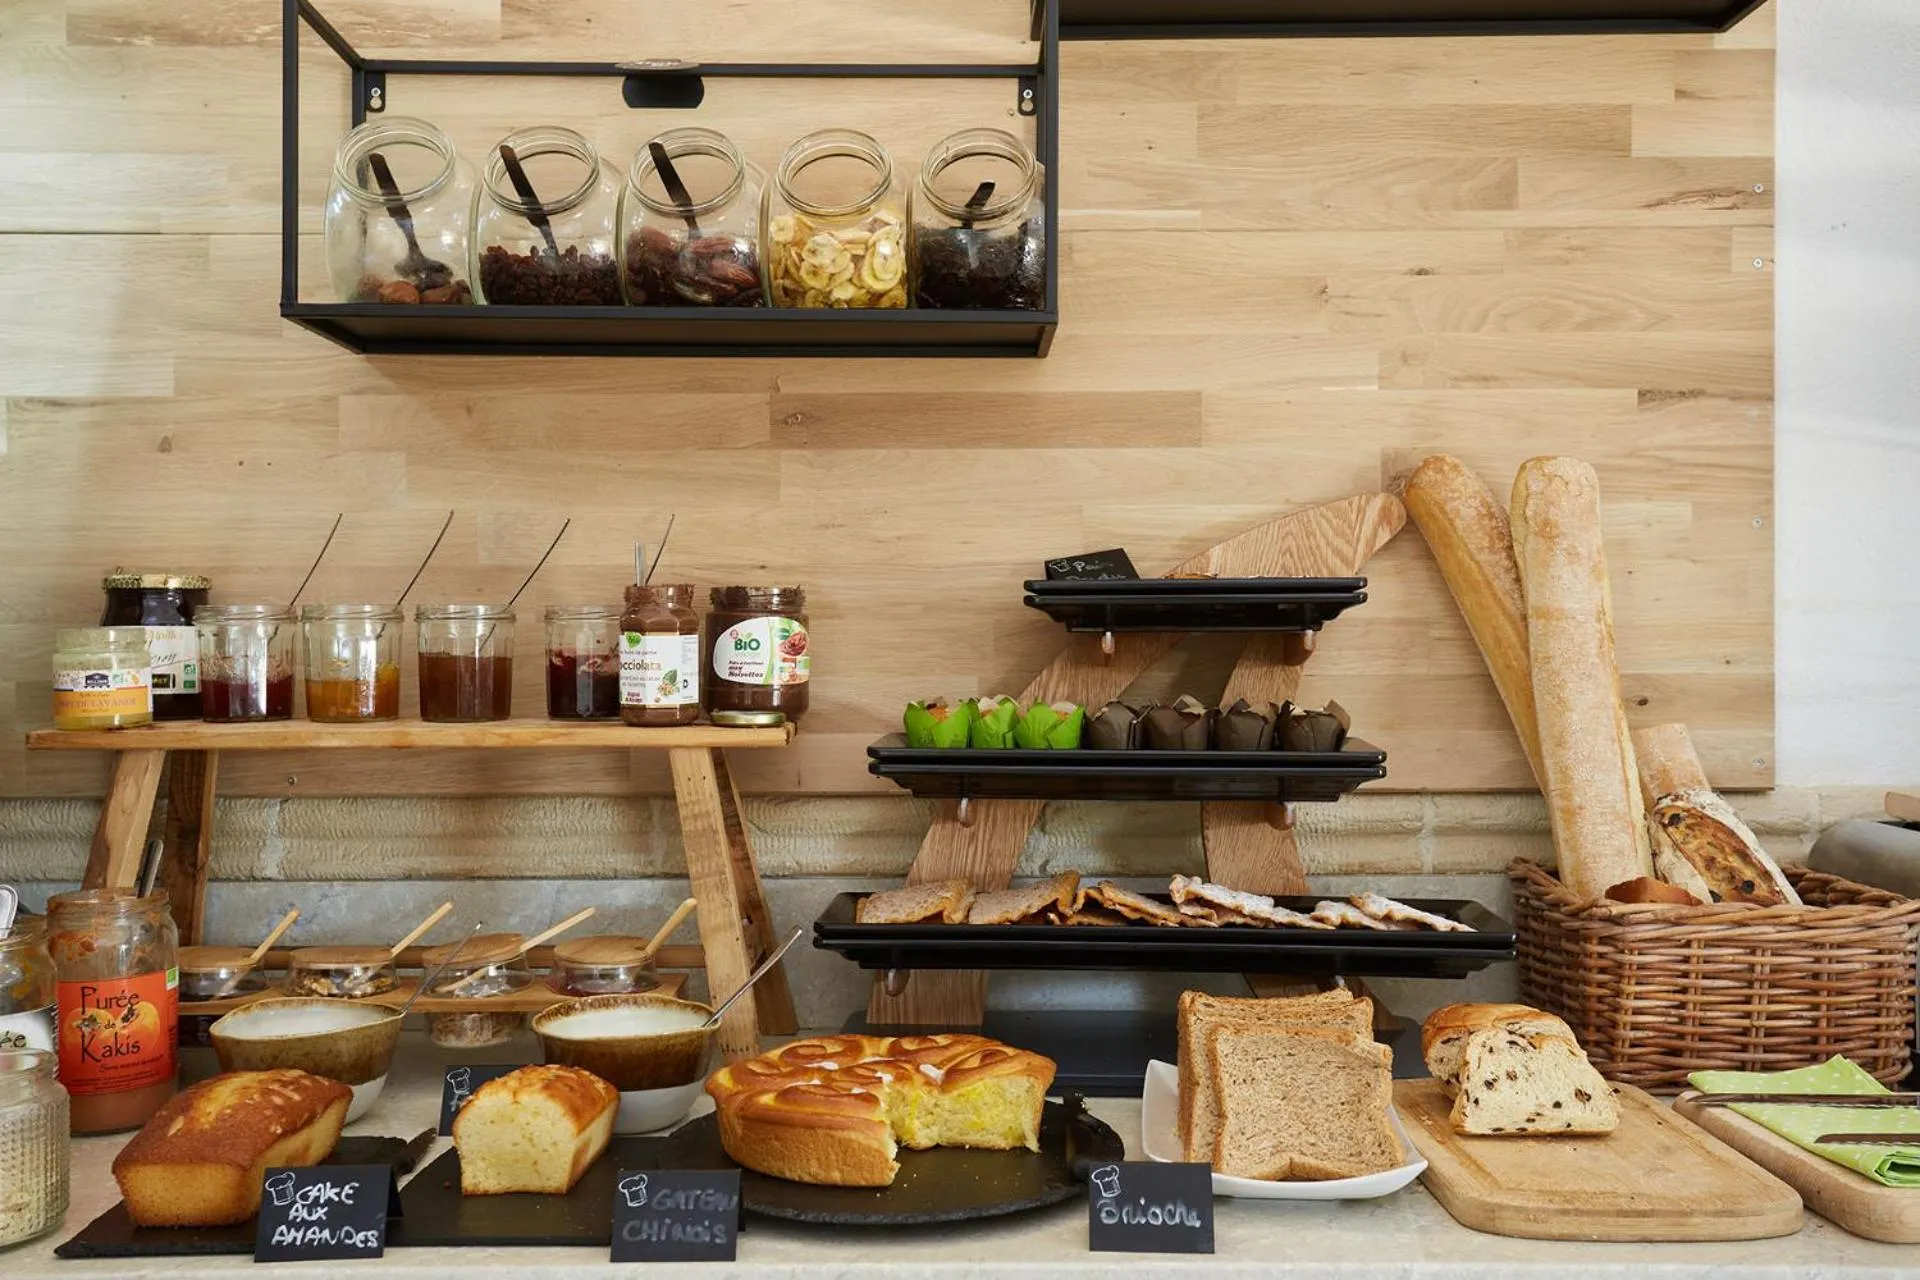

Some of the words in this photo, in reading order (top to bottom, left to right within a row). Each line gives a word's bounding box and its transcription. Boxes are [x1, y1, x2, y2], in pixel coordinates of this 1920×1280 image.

[80, 986, 140, 1016] Purée
[104, 1020, 116, 1030] de
[81, 1026, 141, 1064] Kakis
[295, 1181, 360, 1205] CAKE
[287, 1202, 329, 1222] AUX
[270, 1224, 379, 1248] AMANDES
